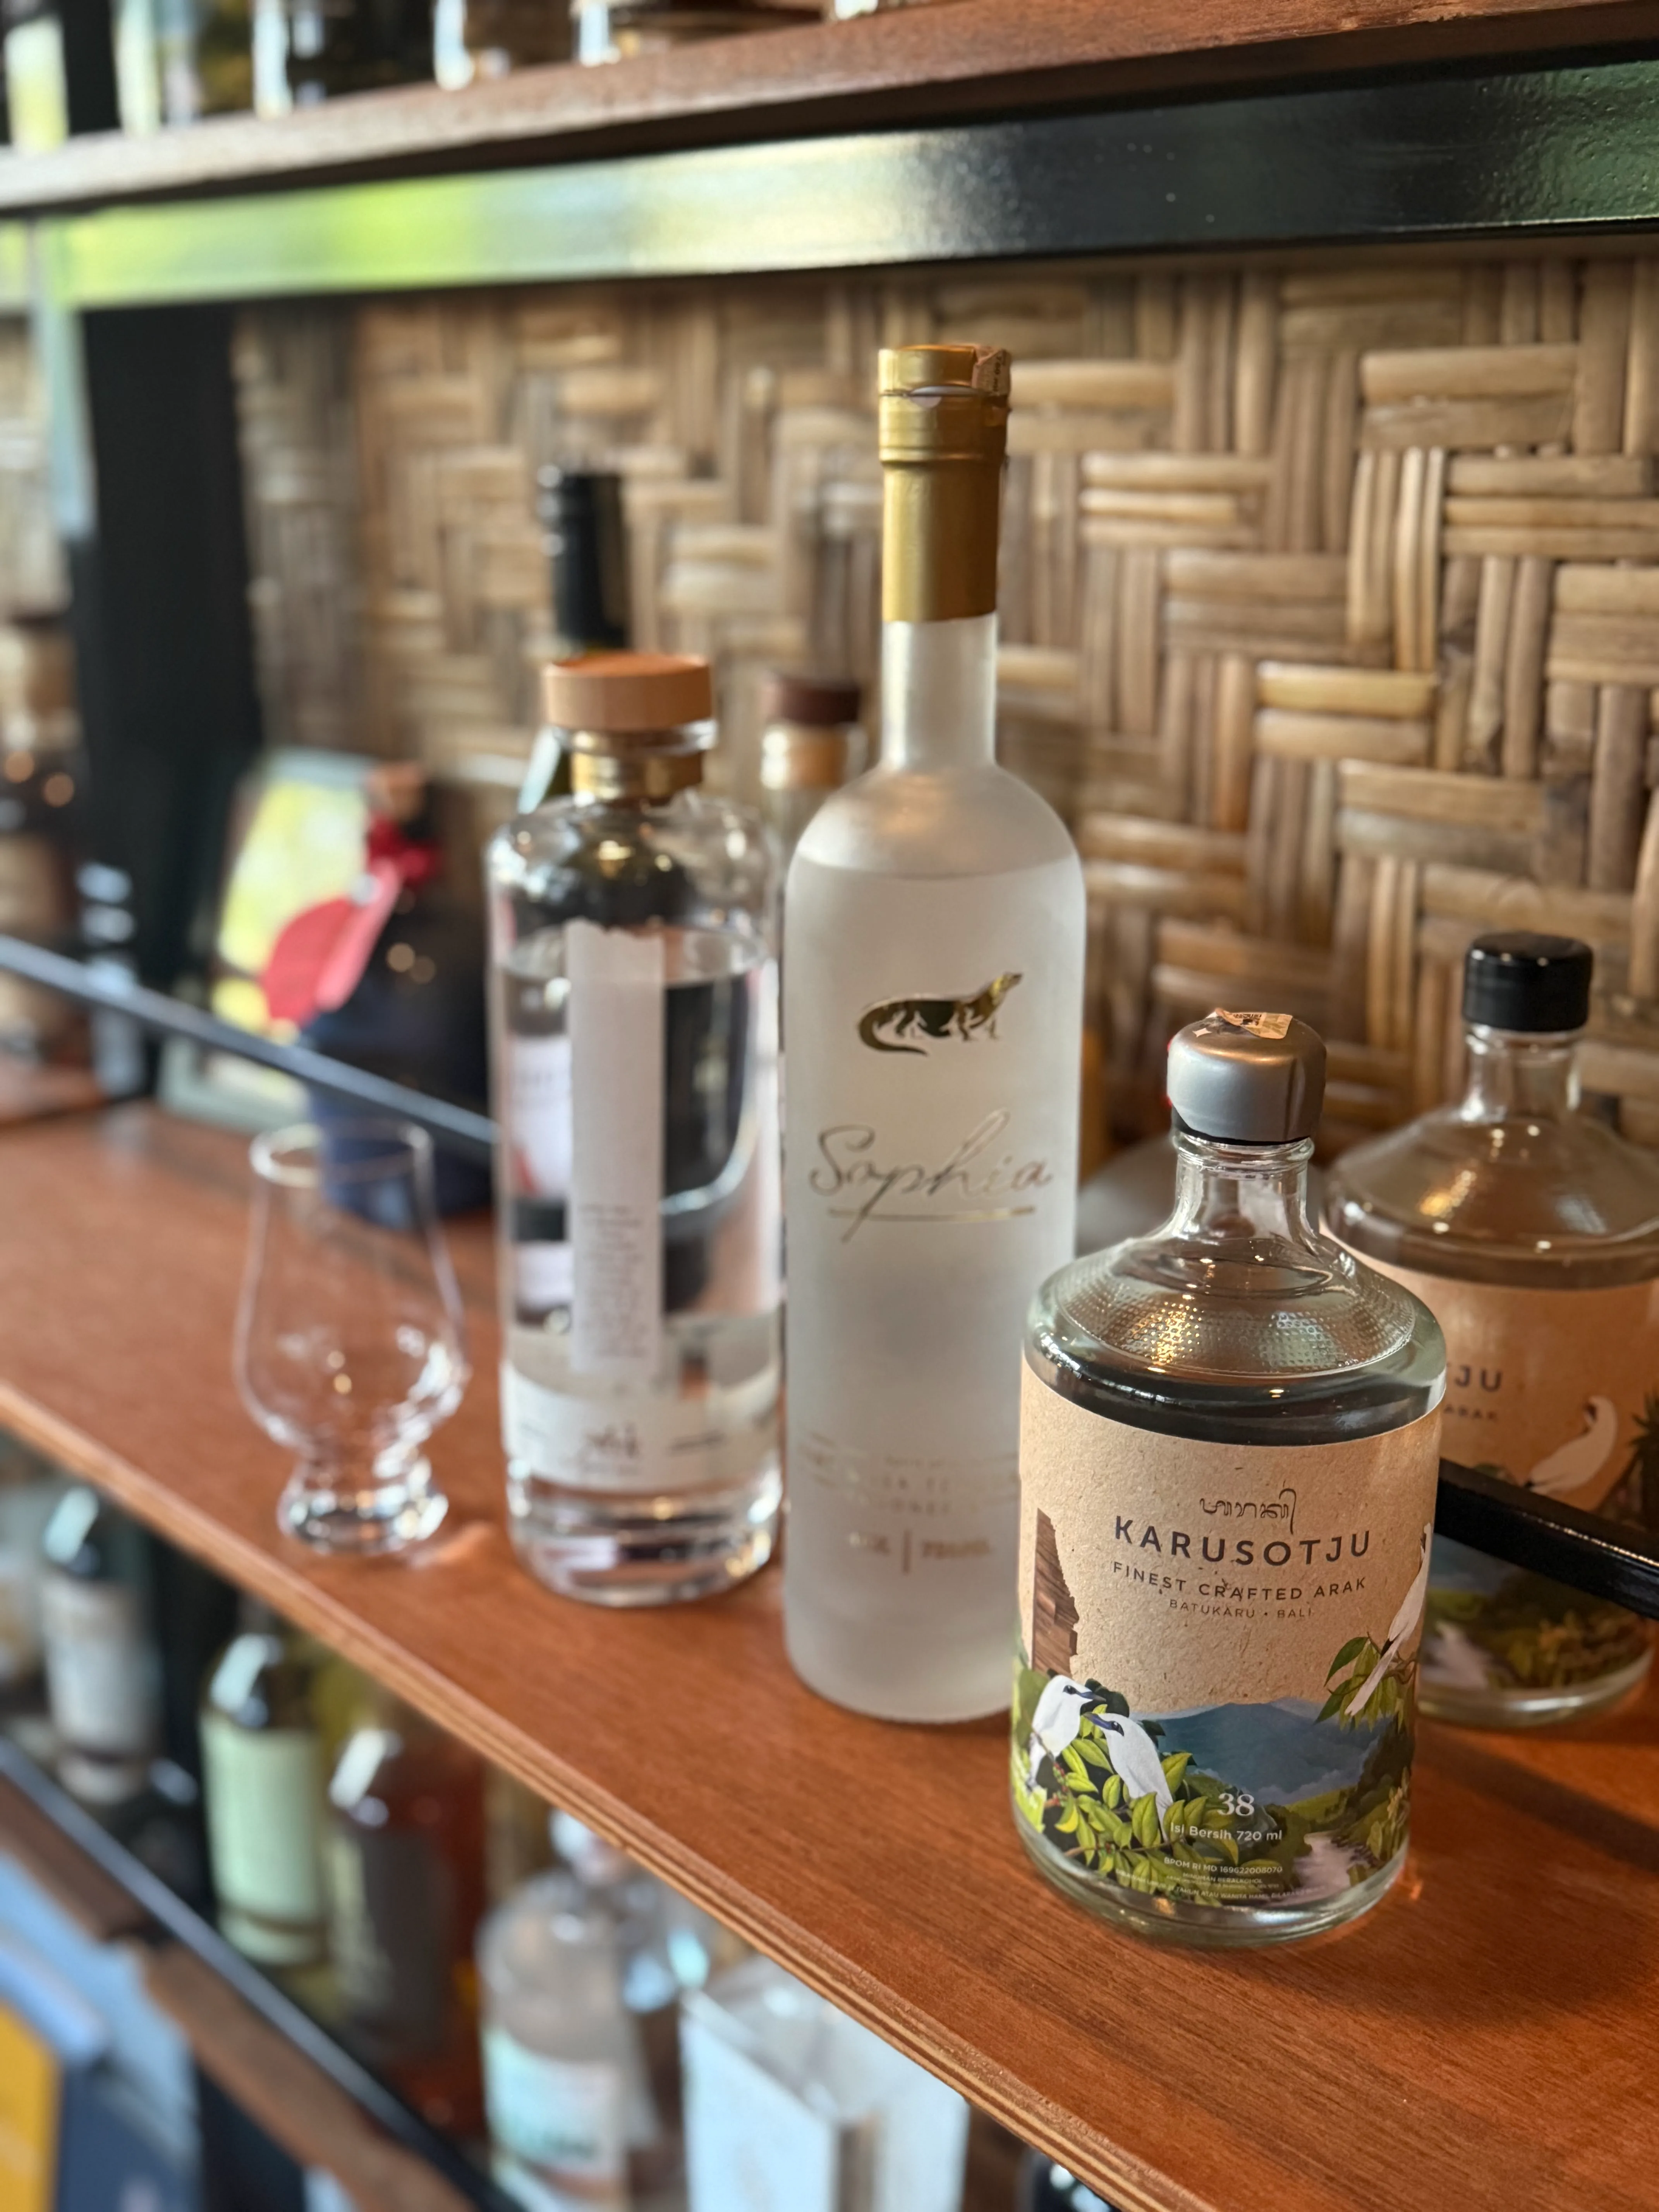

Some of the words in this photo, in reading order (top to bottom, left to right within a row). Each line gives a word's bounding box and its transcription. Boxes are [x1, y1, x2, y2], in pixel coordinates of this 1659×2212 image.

[809, 1108, 1053, 1243] Sophia
[1115, 1515, 1370, 1566] KARUSOTJU
[1113, 1561, 1187, 1592] FINEST
[1199, 1583, 1302, 1600] CRAFTED
[1314, 1577, 1365, 1598] ARAK
[1169, 1599, 1255, 1618] BATUKARU
[1277, 1608, 1312, 1618] BALI
[1217, 1793, 1255, 1817] 38
[1170, 1822, 1185, 1834] Isi
[1189, 1826, 1232, 1840] Bersih
[1236, 1831, 1262, 1841] 720
[1266, 1830, 1282, 1841] ml
[1164, 1857, 1190, 1869] BPOM
[1192, 1862, 1201, 1870] RI
